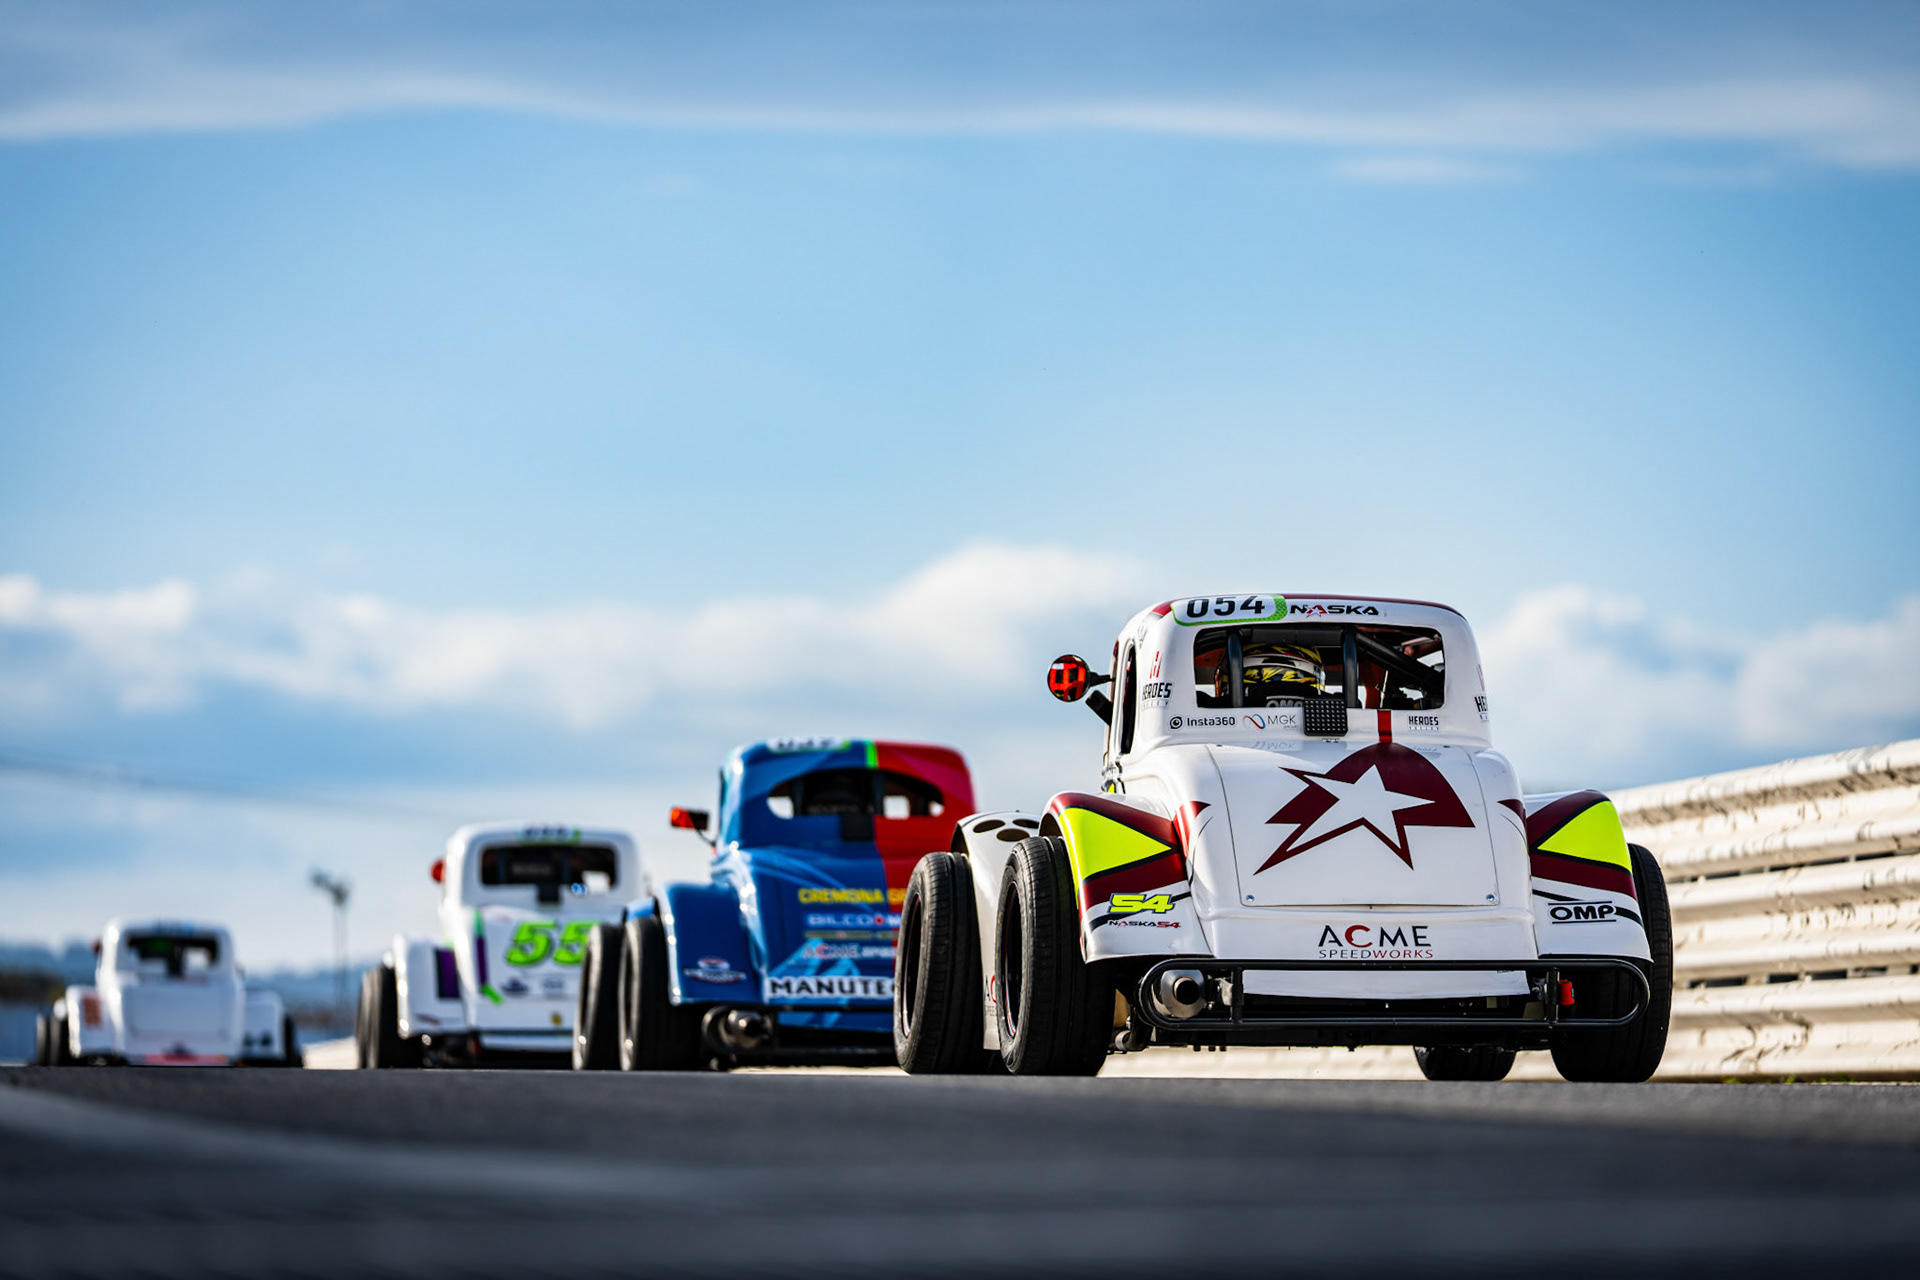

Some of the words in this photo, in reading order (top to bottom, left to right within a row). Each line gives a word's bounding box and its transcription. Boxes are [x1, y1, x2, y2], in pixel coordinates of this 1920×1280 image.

[1186, 596, 1265, 618] 054
[1290, 604, 1379, 618] NASKA
[1142, 682, 1173, 700] HEROES
[1187, 717, 1236, 727] Insta360
[1267, 715, 1297, 725] MGK
[1408, 715, 1439, 726] HEROES
[1108, 893, 1175, 914] 54
[1550, 905, 1614, 920] OMP
[1109, 920, 1181, 928] NASKA54
[506, 920, 601, 966] 55
[1318, 925, 1431, 948] ACME
[1318, 949, 1434, 959] SPEEDWORKS
[770, 978, 895, 995] MANUTE
